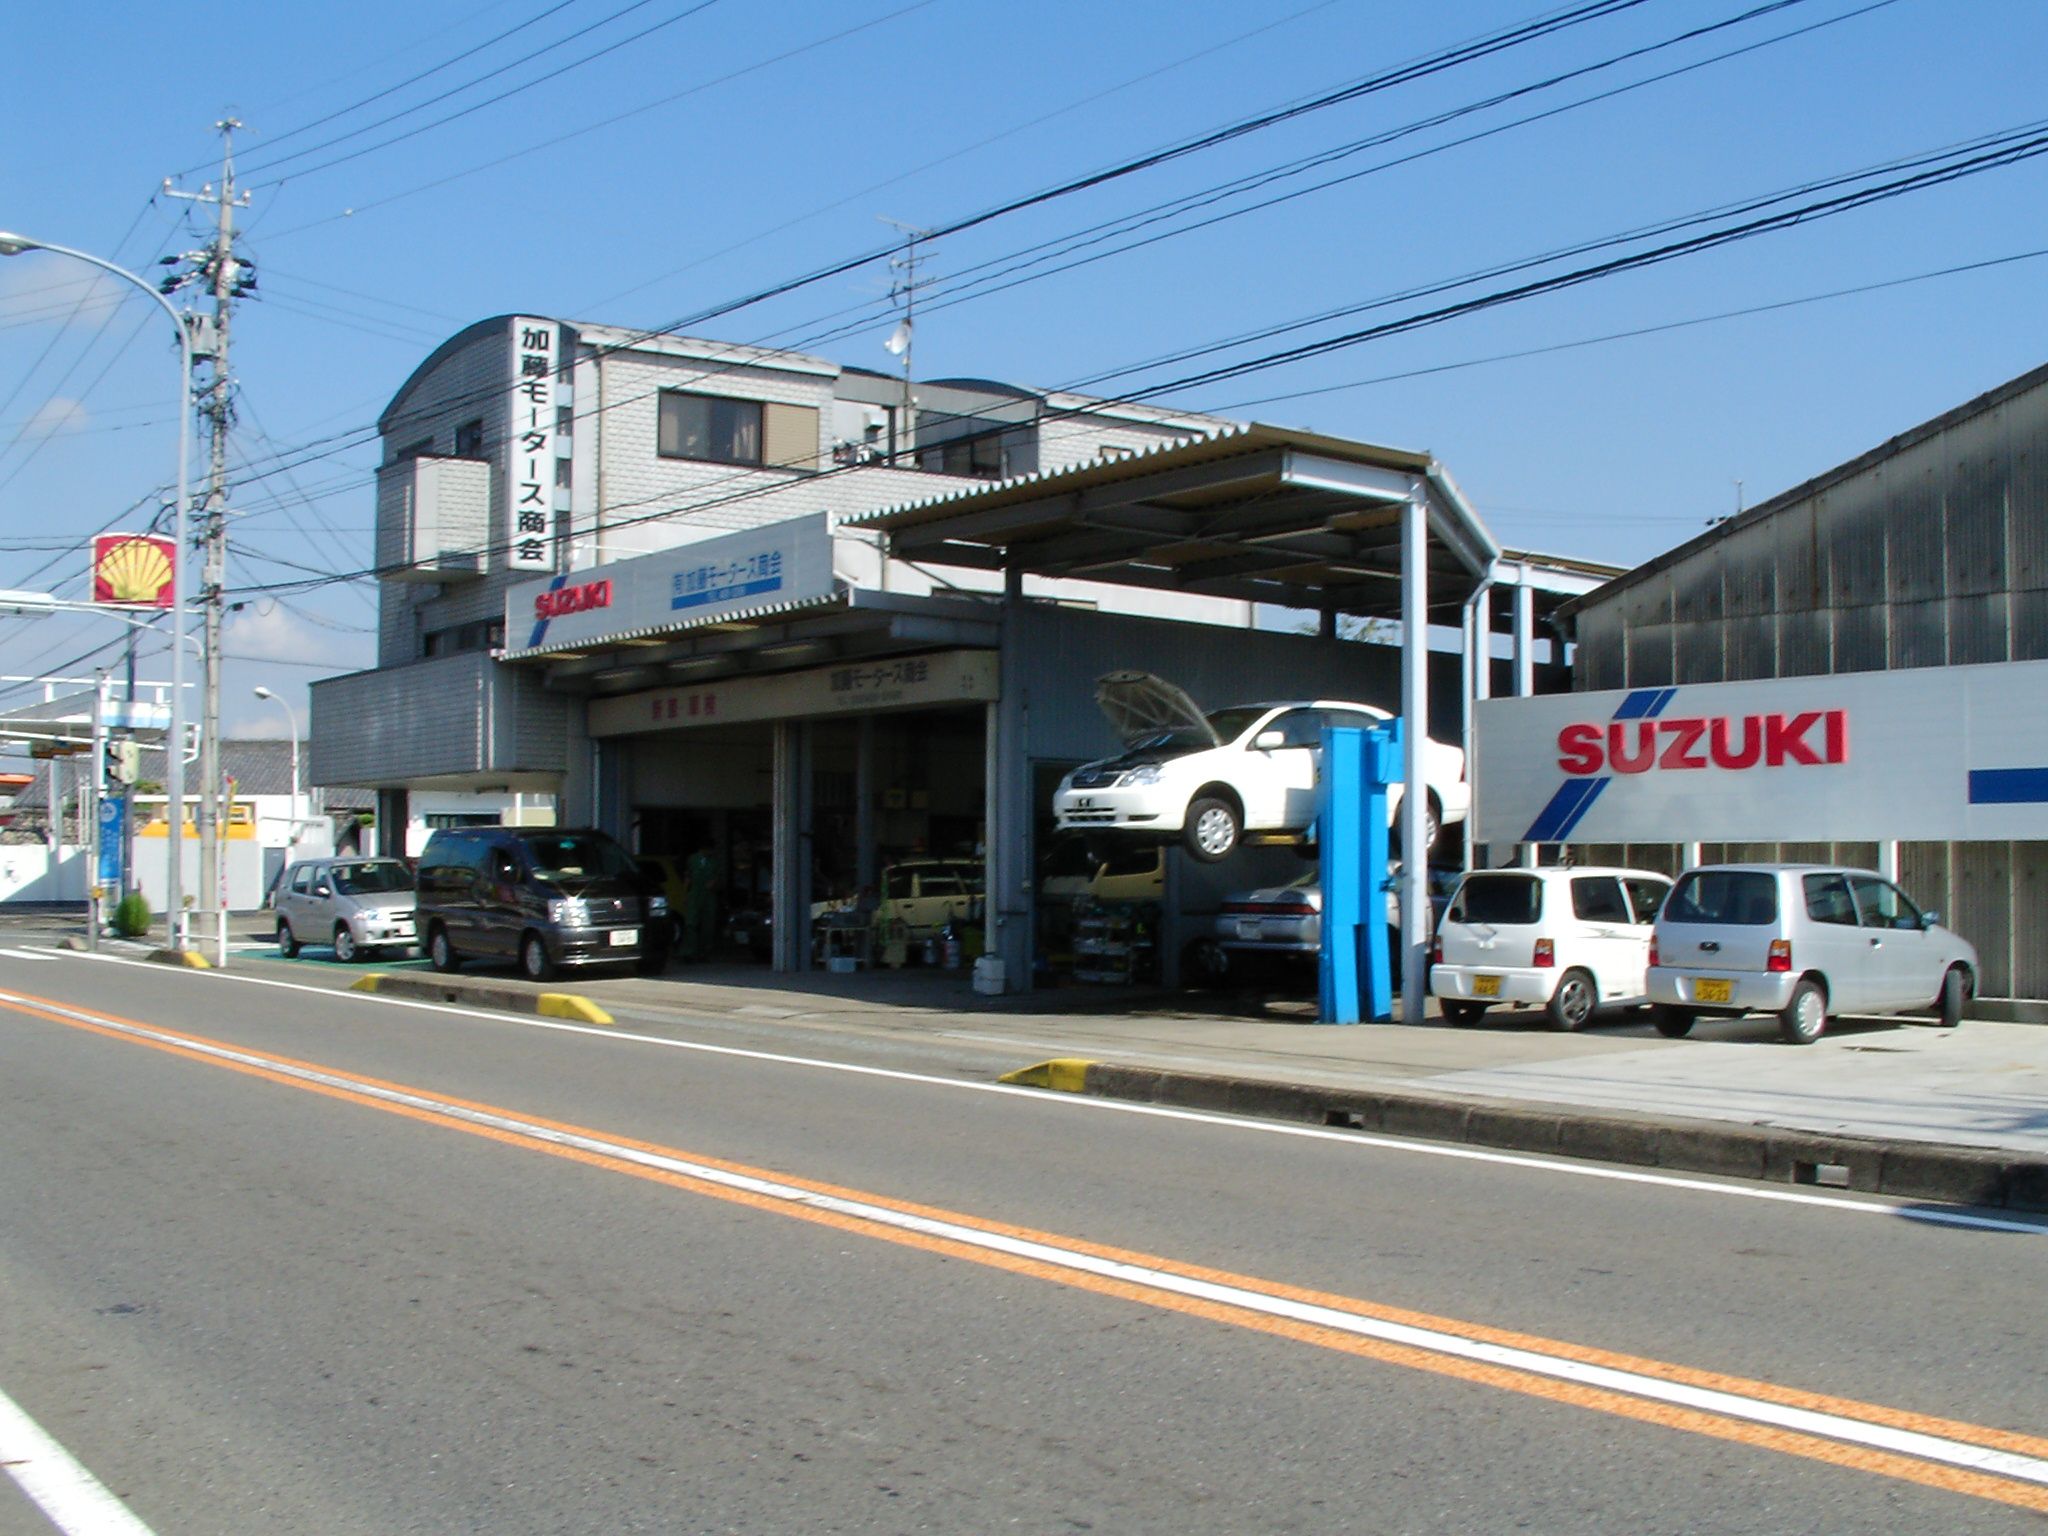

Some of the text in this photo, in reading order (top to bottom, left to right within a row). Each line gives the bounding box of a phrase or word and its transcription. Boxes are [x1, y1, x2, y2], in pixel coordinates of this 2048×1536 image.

[519, 328, 550, 563] 加藤モータース商会
[535, 580, 612, 620] SUZUKI
[1557, 710, 1848, 775] SUZUKI
